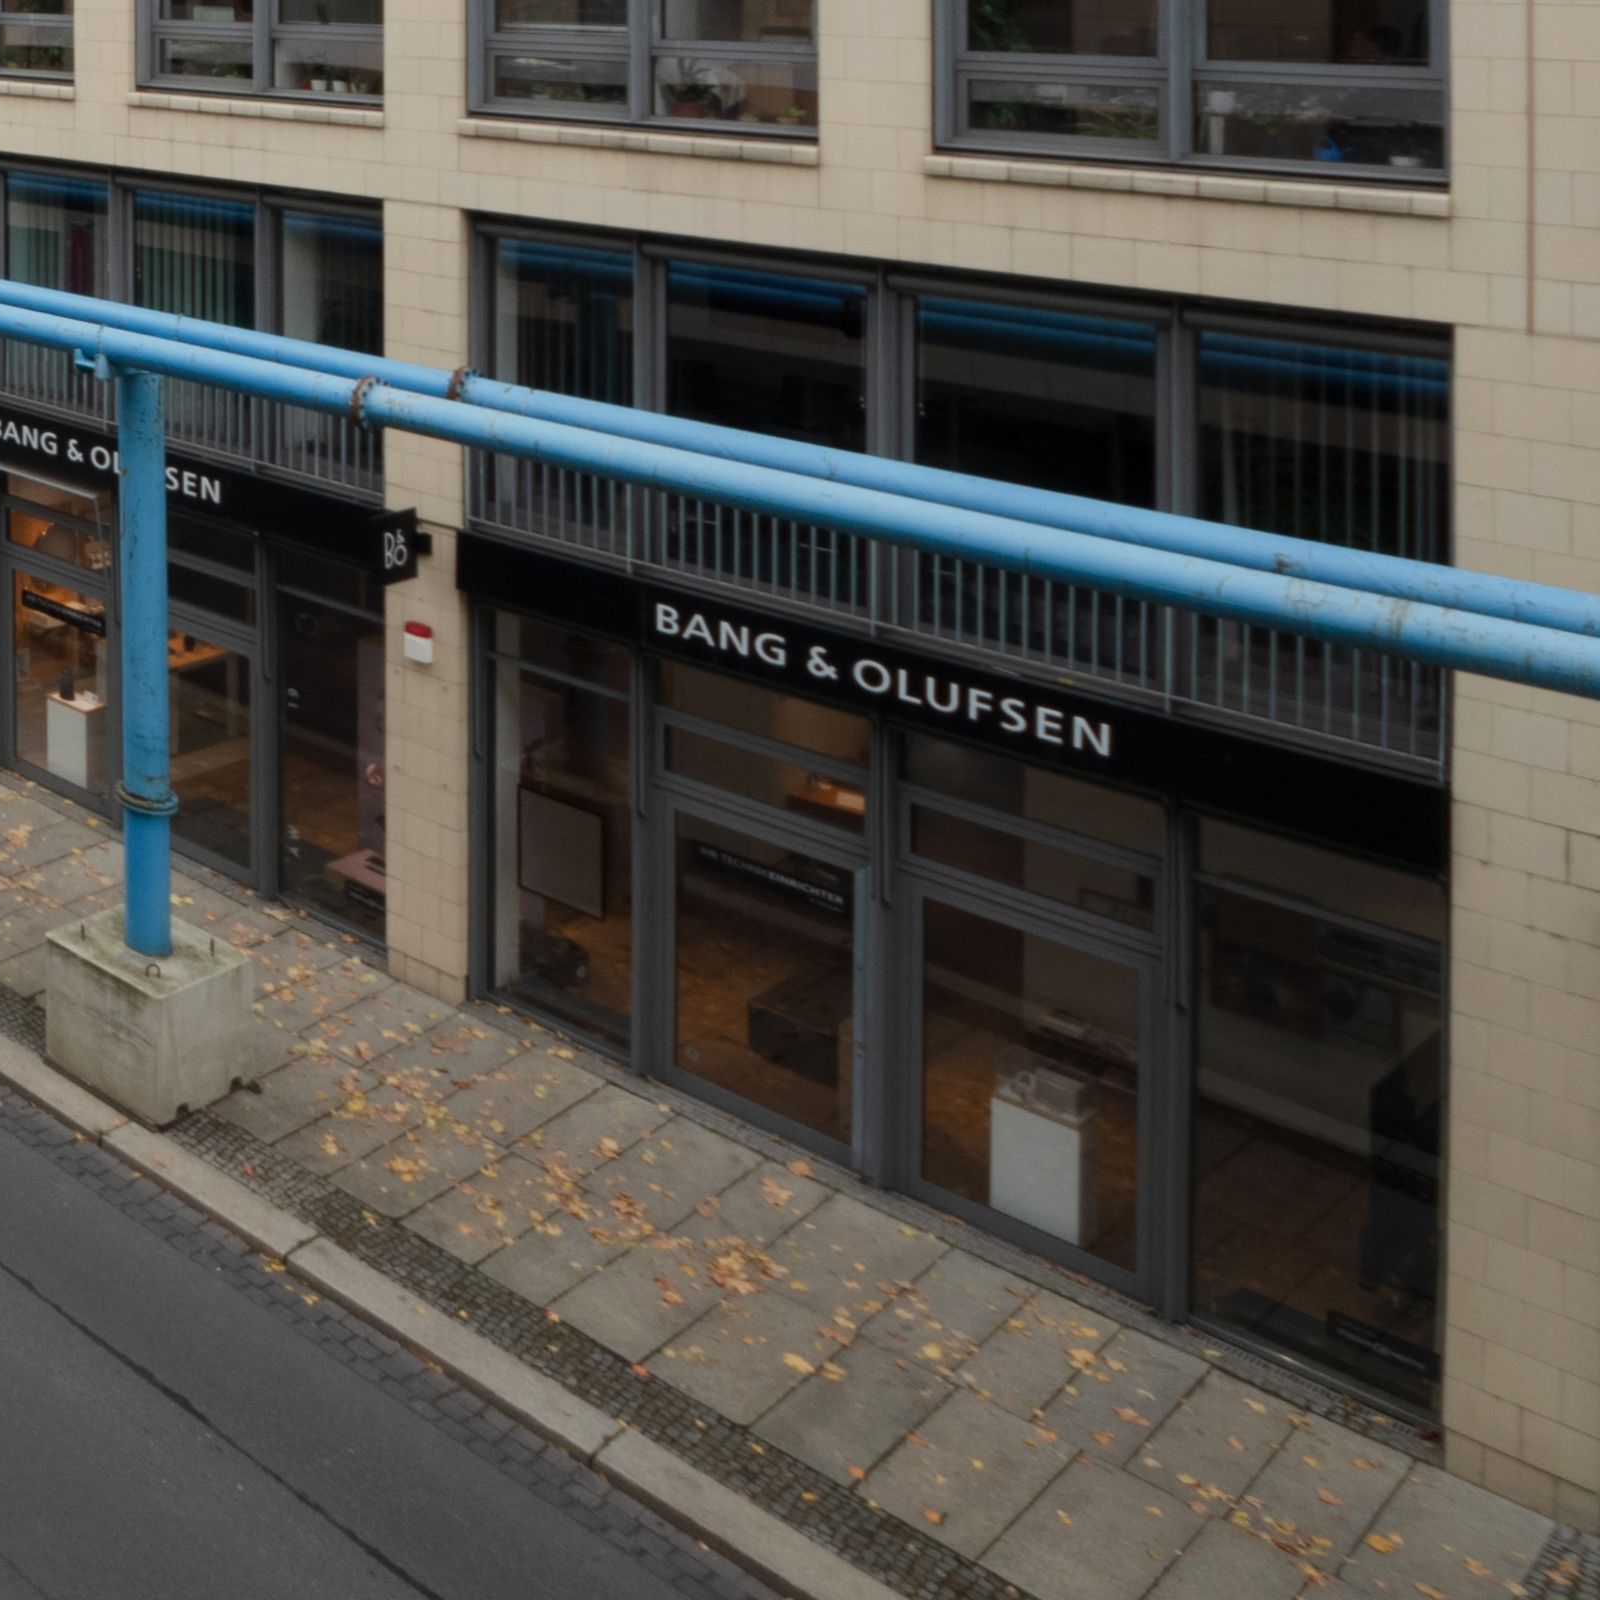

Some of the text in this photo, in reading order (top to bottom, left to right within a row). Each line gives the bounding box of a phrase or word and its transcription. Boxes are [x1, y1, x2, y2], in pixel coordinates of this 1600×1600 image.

[66, 439, 84, 464] &
[90, 446, 221, 504] OLSEN
[655, 603, 1111, 757] BANG & OLUFSEN
